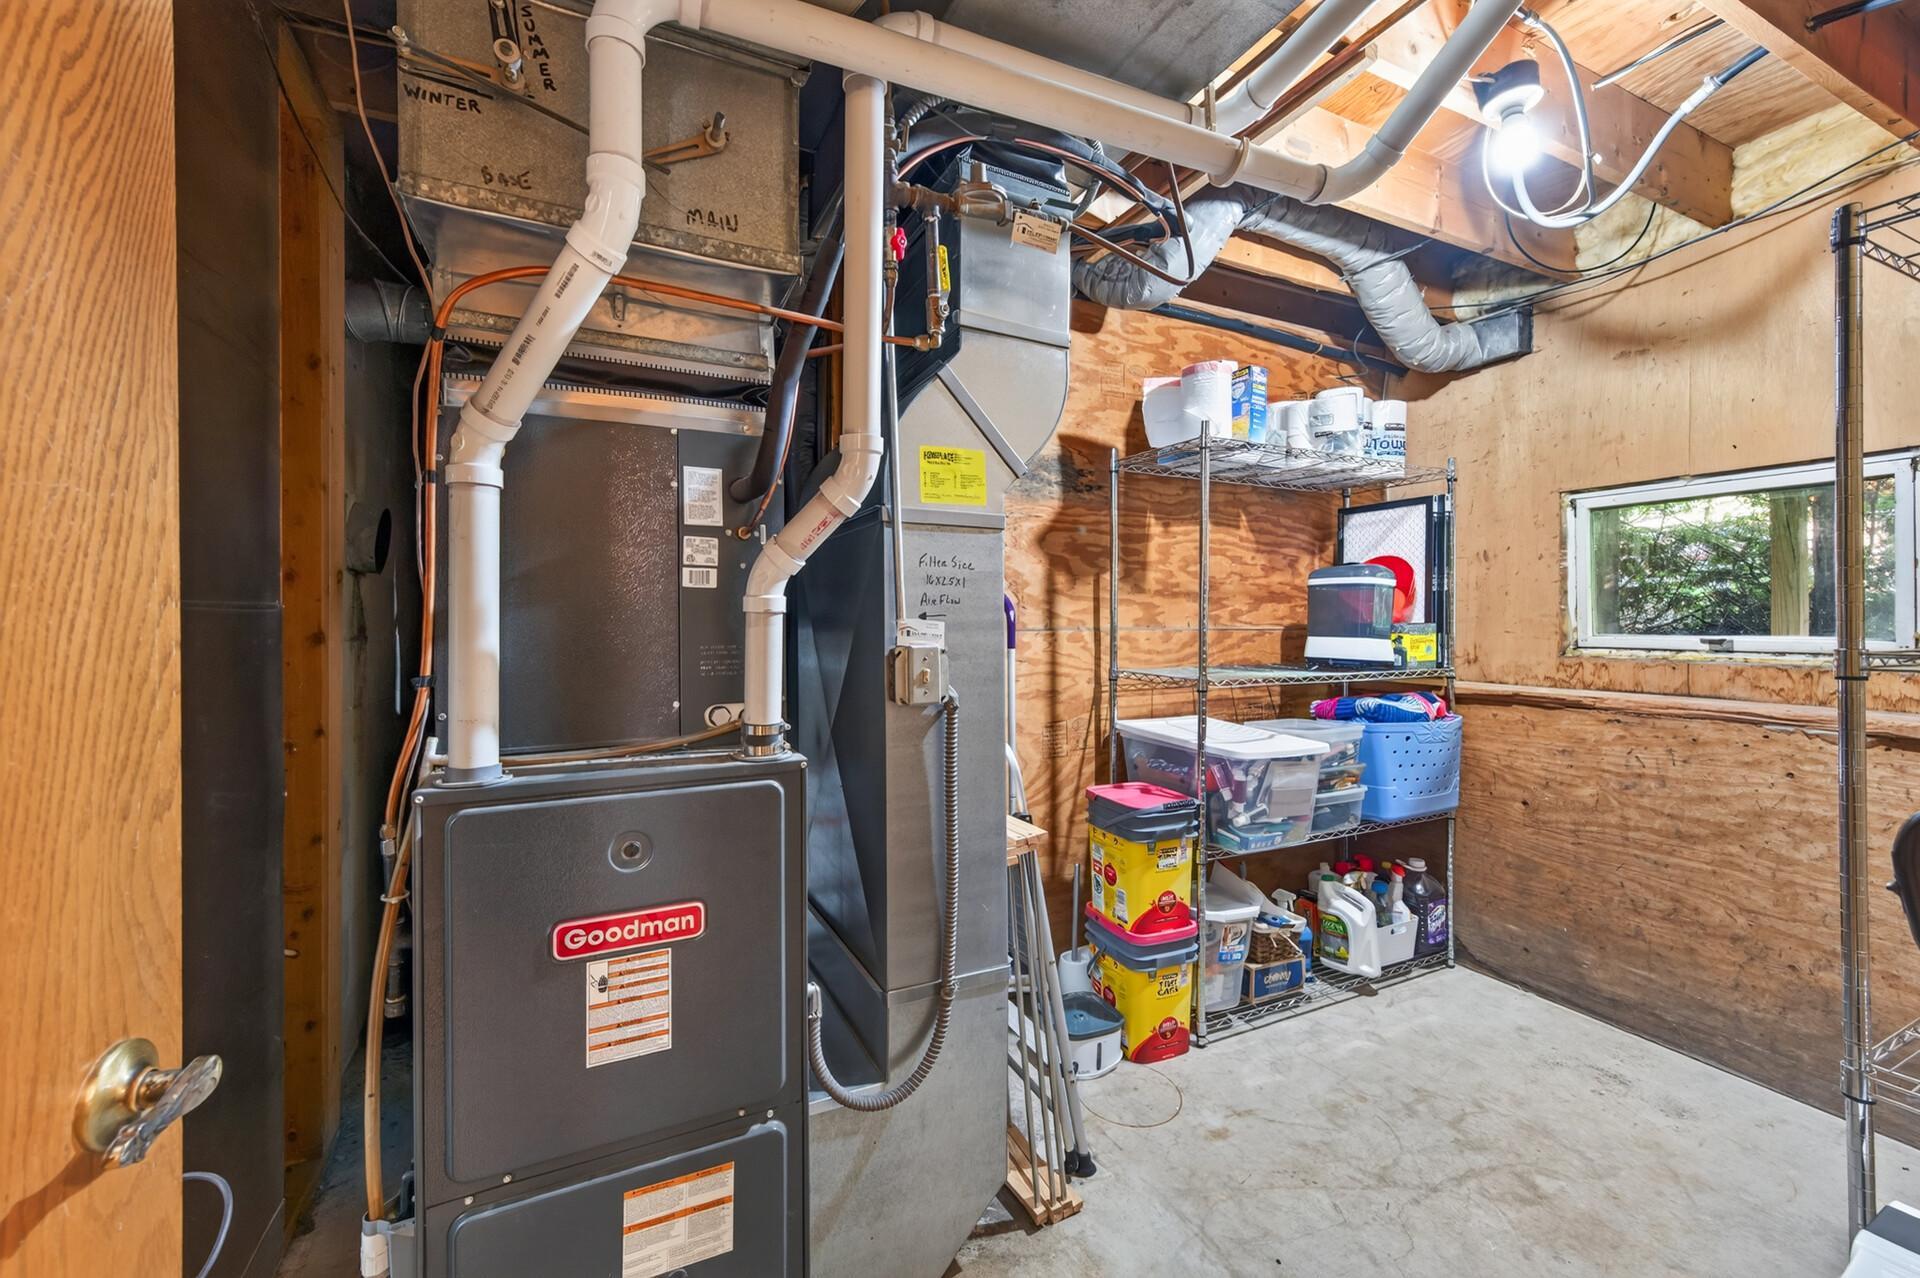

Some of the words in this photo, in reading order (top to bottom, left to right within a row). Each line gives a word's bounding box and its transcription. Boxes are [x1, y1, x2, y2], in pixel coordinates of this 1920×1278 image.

[521, 5, 557, 92] SUMMER
[402, 82, 482, 115] WINTER
[480, 165, 532, 191] BASE
[686, 208, 739, 233] MAIN
[564, 914, 695, 950] Goodman
